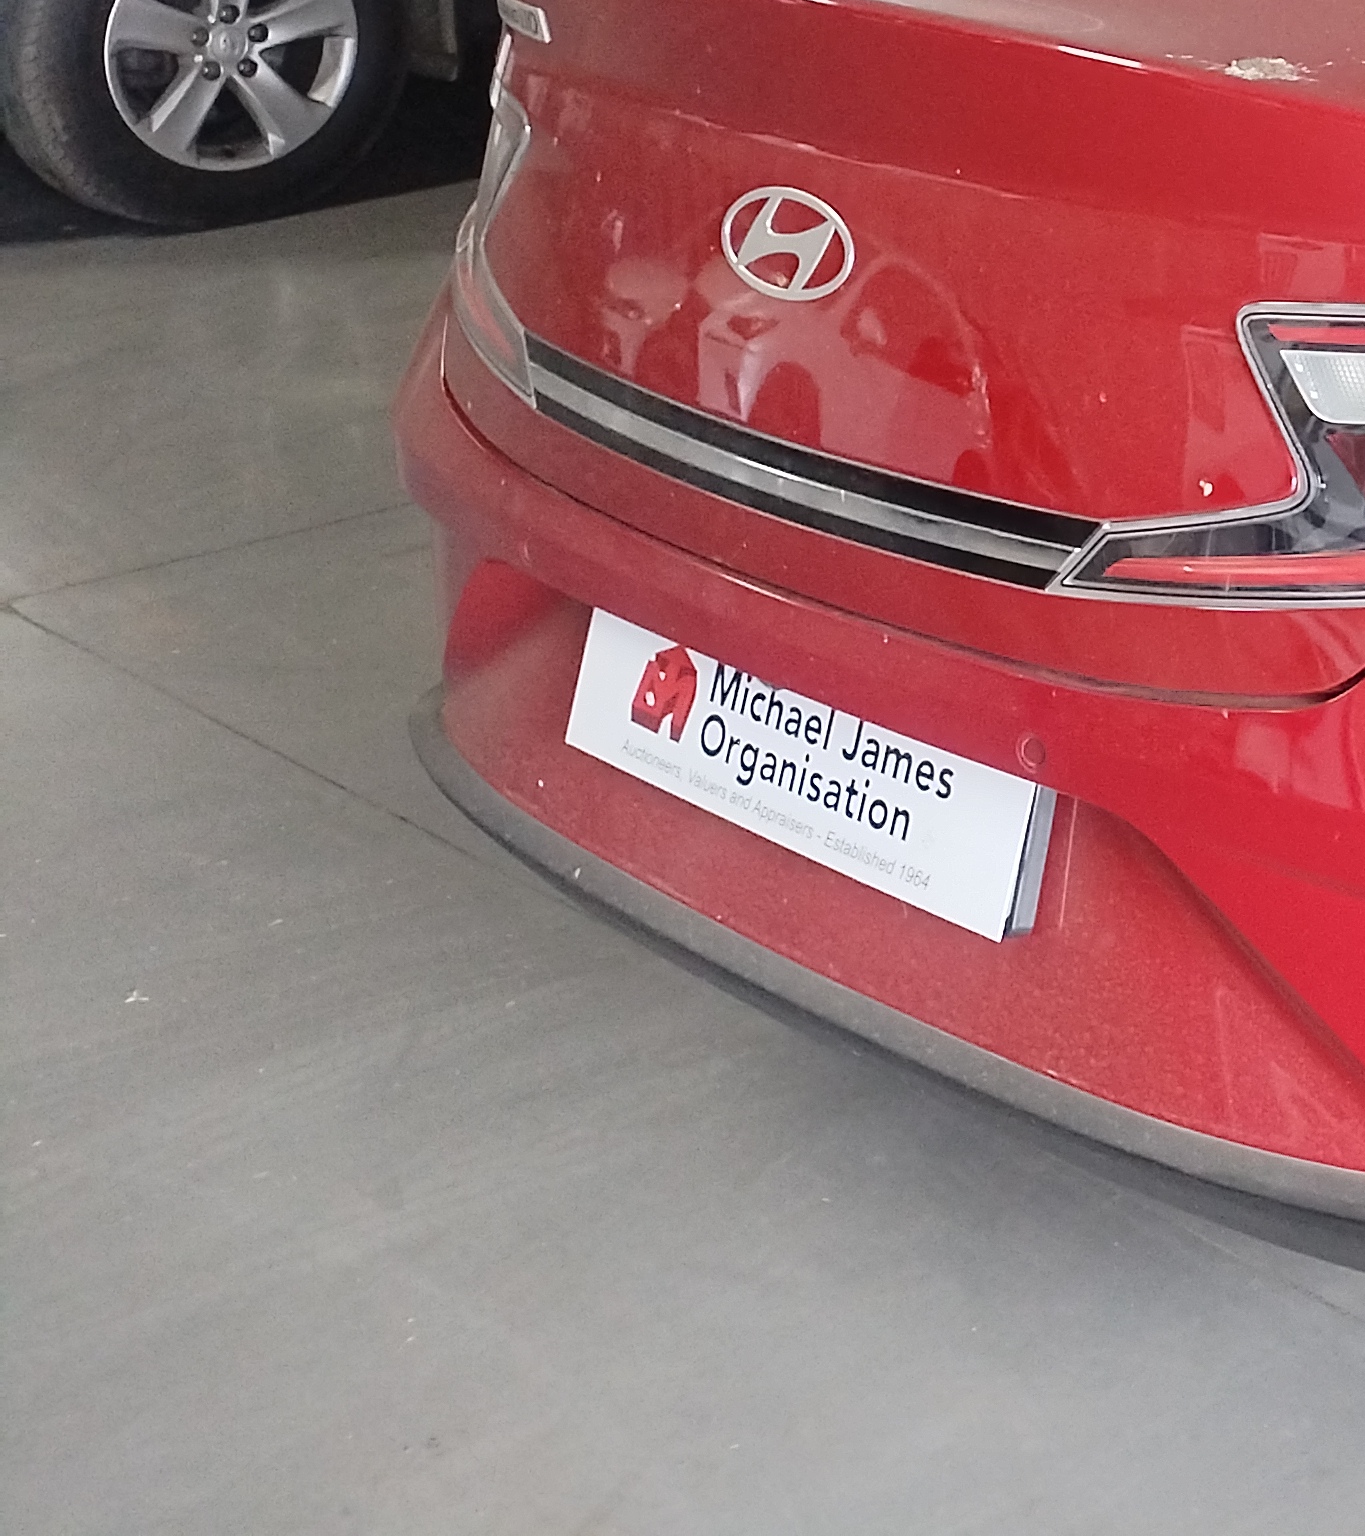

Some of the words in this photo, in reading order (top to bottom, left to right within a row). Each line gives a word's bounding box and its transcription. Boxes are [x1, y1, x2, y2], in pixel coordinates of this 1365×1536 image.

[701, 714, 911, 842] Organisation
[709, 662, 836, 750] Michael
[842, 720, 955, 800] James
[899, 864, 931, 890] 1964
